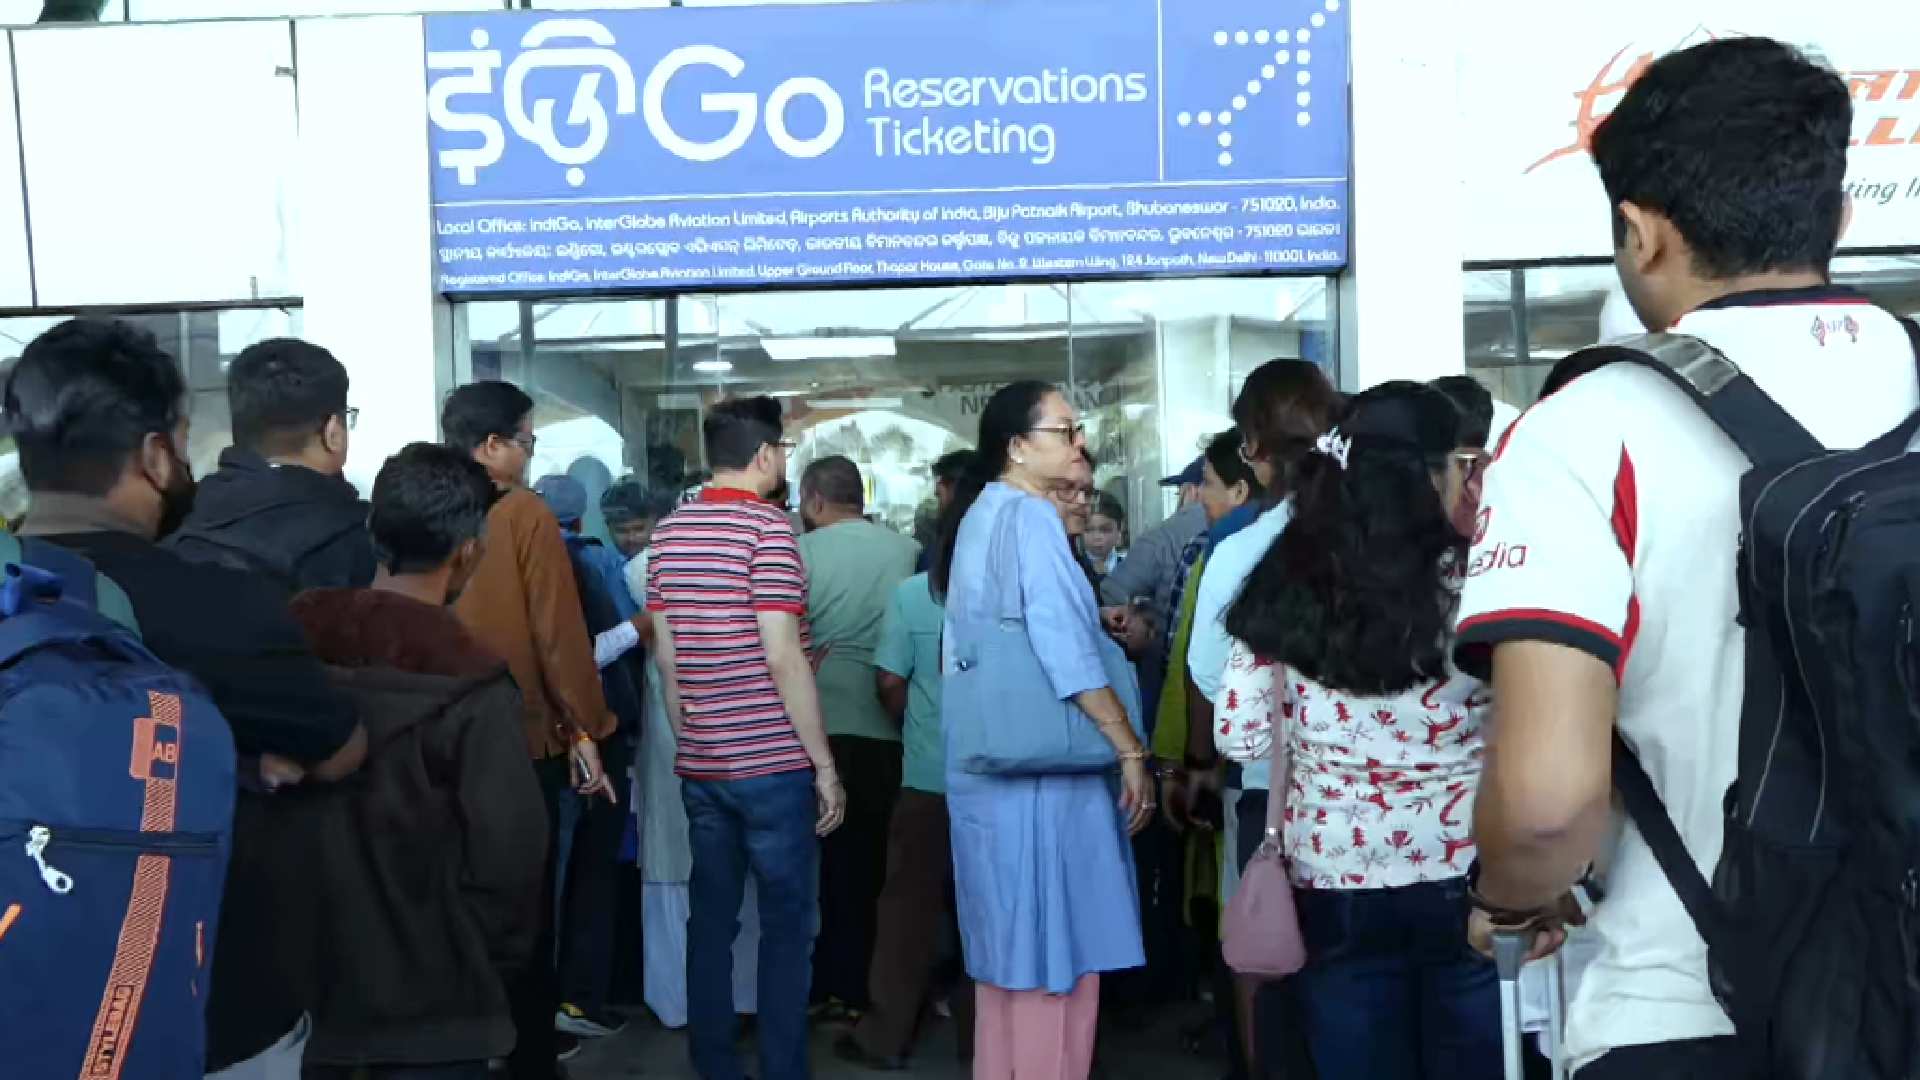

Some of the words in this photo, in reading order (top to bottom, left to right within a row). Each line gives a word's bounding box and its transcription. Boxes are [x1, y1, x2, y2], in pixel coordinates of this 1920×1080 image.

[864, 67, 1148, 109] Reservations
[867, 117, 1056, 164] Ticketing
[437, 218, 474, 235] Local
[669, 212, 731, 228] Aviation
[791, 208, 849, 228] Airports
[851, 206, 920, 224] Authority
[923, 206, 938, 221] of
